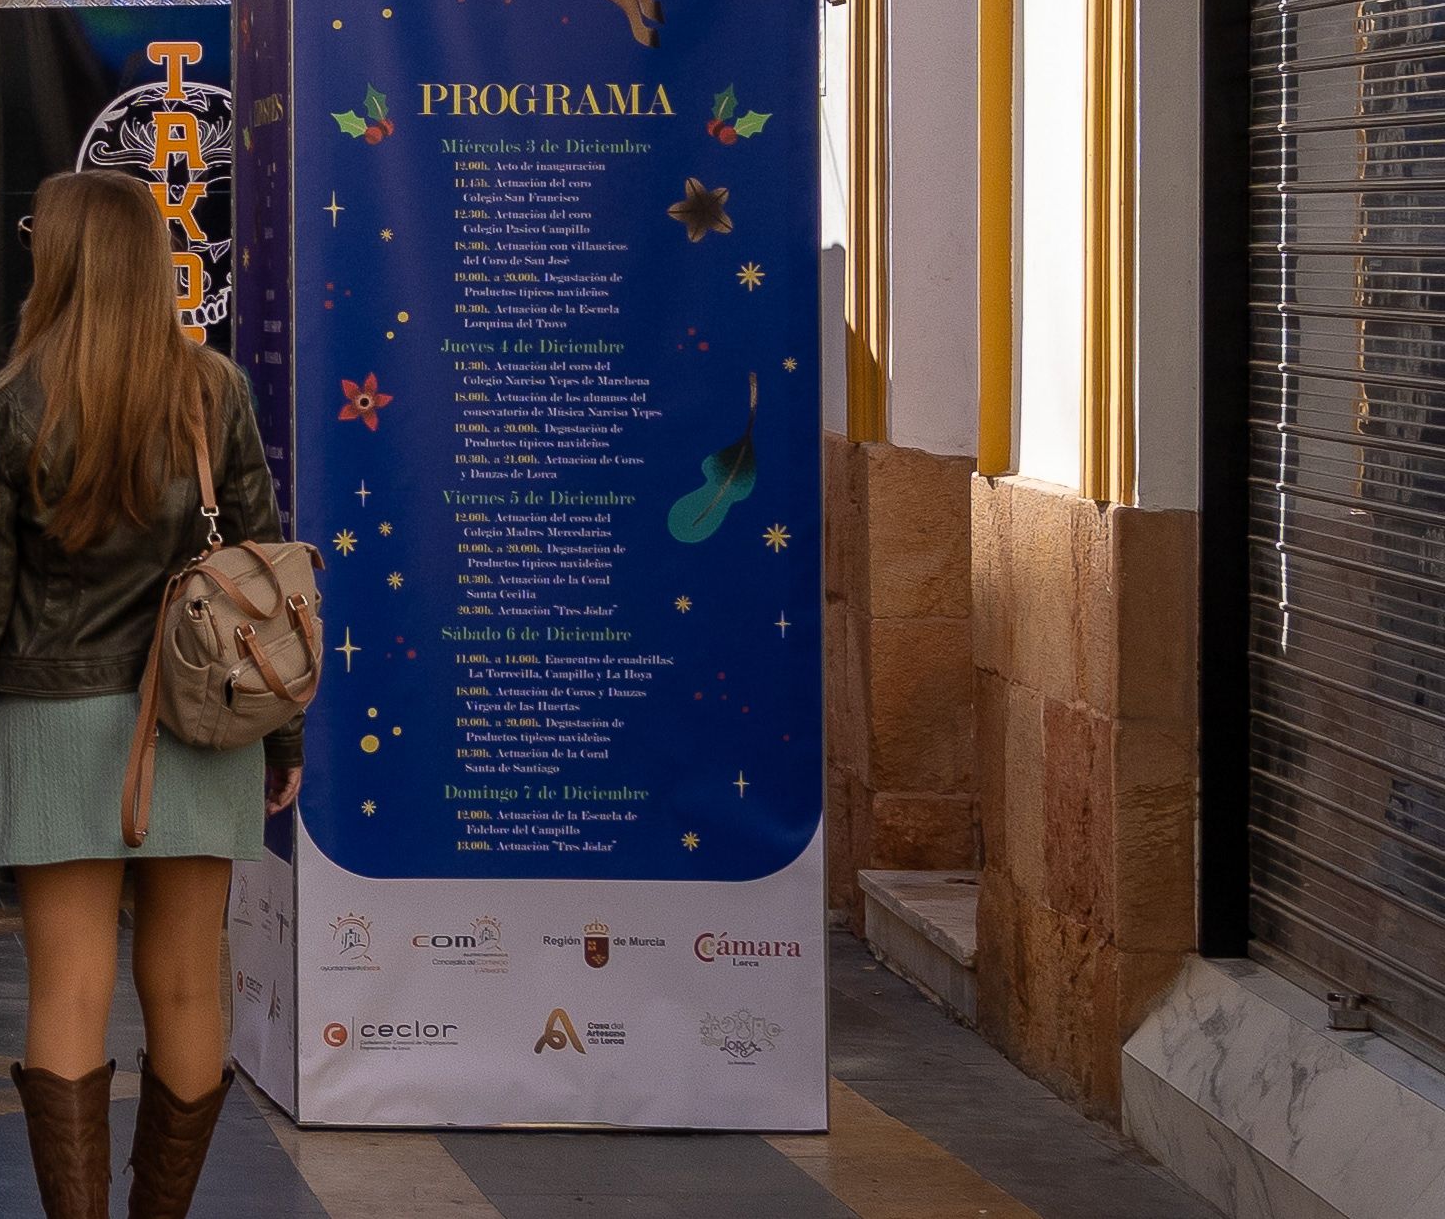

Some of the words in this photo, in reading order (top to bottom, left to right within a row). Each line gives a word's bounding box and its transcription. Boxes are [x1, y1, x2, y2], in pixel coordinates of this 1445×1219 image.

[418, 83, 676, 116] PROGRAMA
[441, 139, 522, 154] Miércoles
[525, 140, 536, 153] 3
[540, 140, 560, 153] de
[566, 140, 652, 154] Diciembre
[440, 339, 495, 353] Jueves
[499, 339, 509, 353] 4
[513, 339, 533, 353] de
[540, 340, 625, 354] Diciembre
[442, 491, 505, 505] Viernes
[509, 491, 520, 505] 5
[524, 491, 544, 505] de
[550, 491, 636, 505] Diciembre
[441, 627, 502, 641] Sábado
[506, 627, 516, 641] 6
[520, 627, 540, 641] de
[546, 627, 632, 642] Diciembre
[519, 702, 535, 711] las
[444, 785, 519, 802] Domingo
[523, 786, 532, 800] 7
[538, 786, 557, 800] de
[563, 786, 650, 801] Diciembre
[511, 825, 529, 835] del
[543, 935, 580, 947] Región
[613, 936, 626, 946] de
[629, 936, 666, 947] Murcia
[693, 932, 802, 963] Cámara
[732, 958, 759, 967] Lorca
[360, 1019, 458, 1038] ceclor
